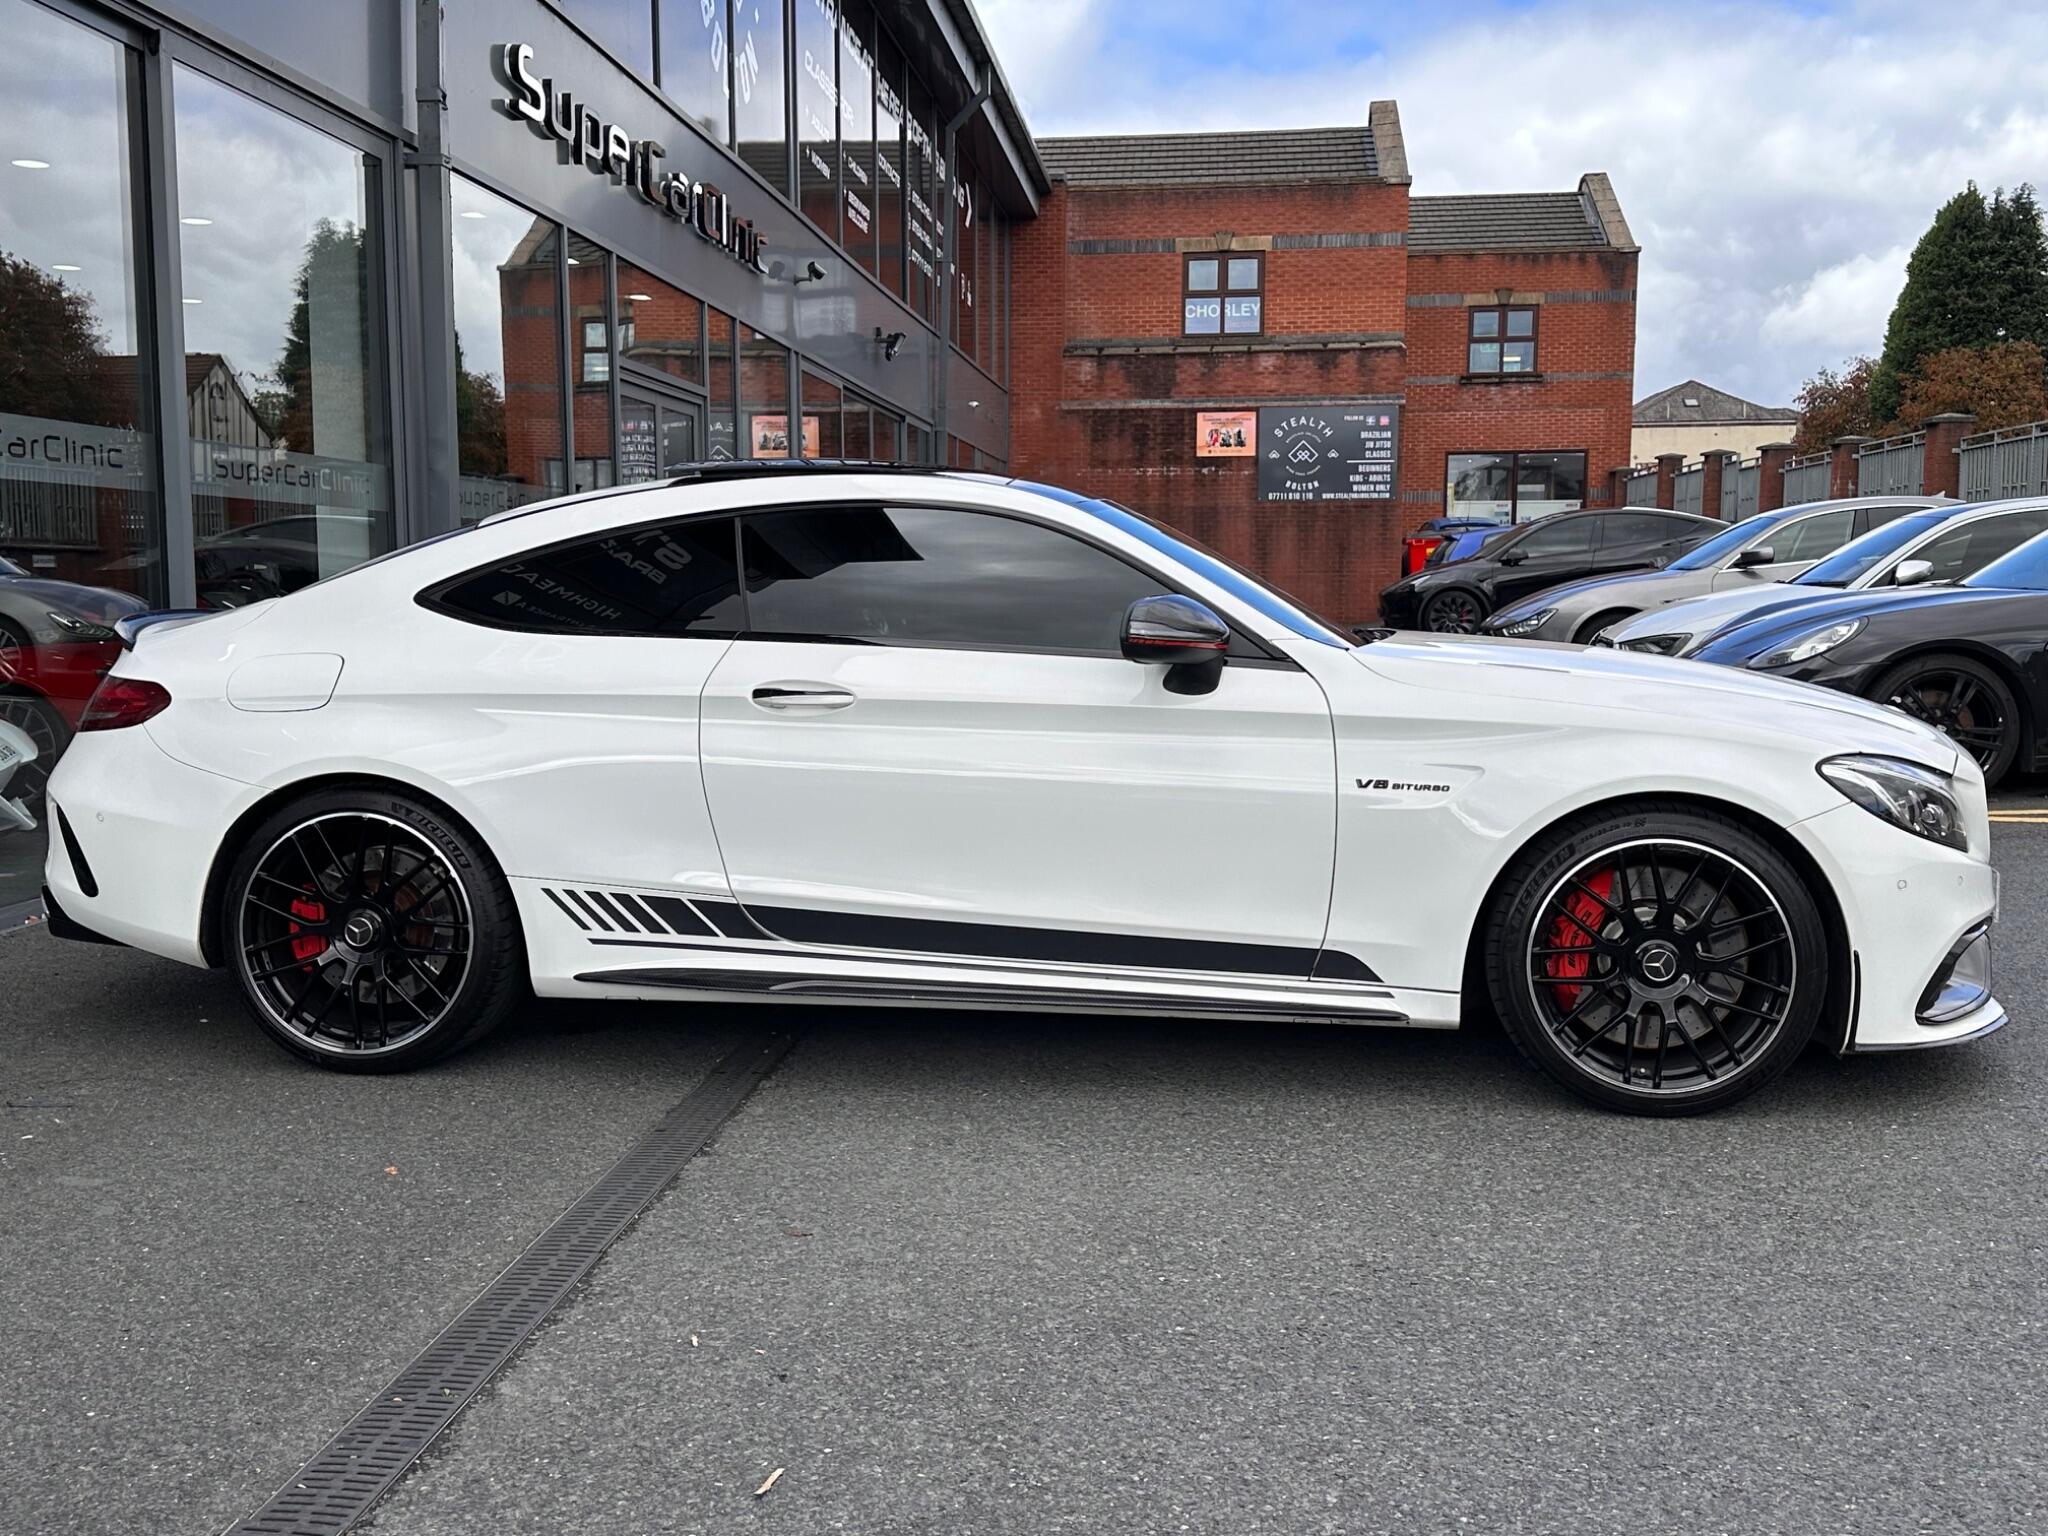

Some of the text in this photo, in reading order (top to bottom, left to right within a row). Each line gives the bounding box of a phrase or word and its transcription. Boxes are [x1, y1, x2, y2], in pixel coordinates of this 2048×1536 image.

[502, 42, 769, 274] SuperCarClinic
[1186, 303, 1260, 318] CHORLEY
[1274, 415, 1334, 438] STEALTH
[1360, 431, 1392, 439] BRAZILIAN
[0, 428, 124, 469] arClinic
[1375, 440, 1392, 449] JITSU
[1365, 450, 1392, 458] CLASSES
[1358, 464, 1392, 472] BEGINNERS
[214, 456, 371, 495] SuperCarClinic
[1349, 474, 1391, 482] KIDS ADULTS
[1285, 480, 1320, 491] BOLTON
[1352, 484, 1391, 492] WOMEN ONLY
[1355, 778, 1451, 793] V8 BITURBO
[408, 811, 471, 867] MICHELIN
